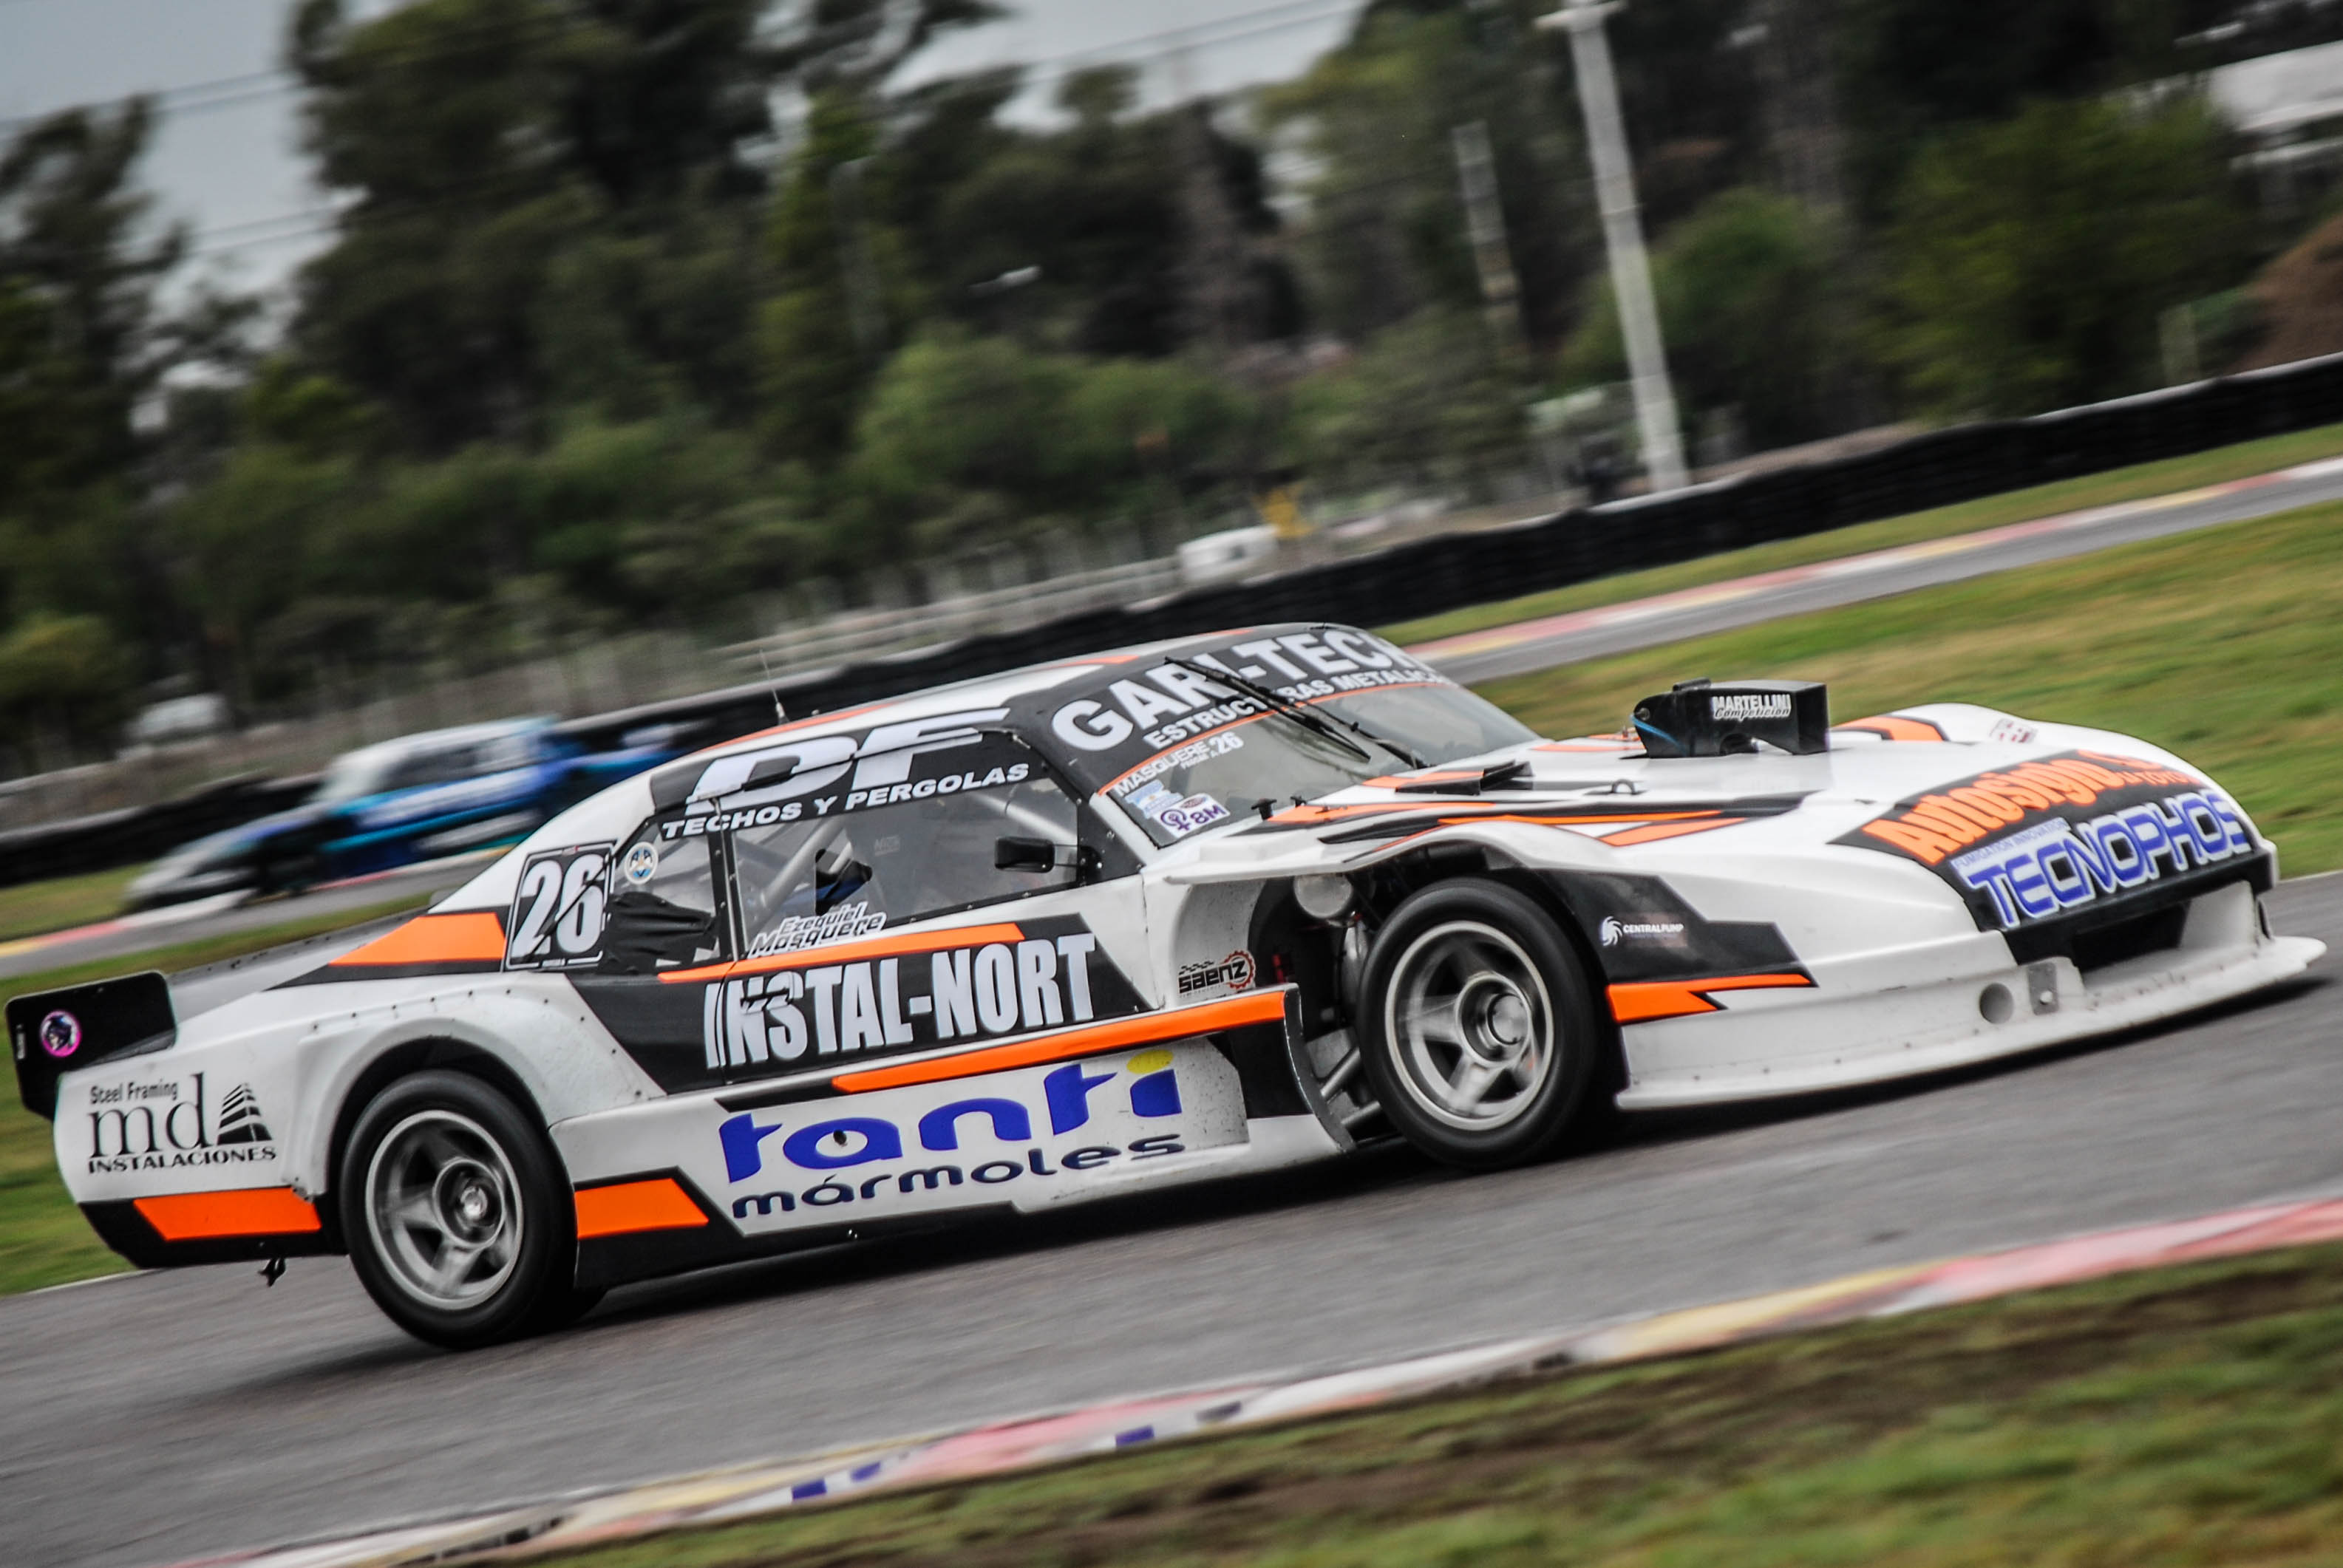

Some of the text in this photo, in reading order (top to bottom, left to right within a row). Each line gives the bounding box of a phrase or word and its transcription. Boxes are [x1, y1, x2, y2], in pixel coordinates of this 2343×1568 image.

[1143, 679, 1335, 749] ESTRUCTRAS
[1711, 694, 1791, 710] MARTELLINI
[684, 708, 1010, 816] DF
[1113, 740, 1211, 797] MASQUERE
[1209, 731, 1244, 754] 26
[662, 763, 1030, 839] TECHOS Y PERGOLAS
[1190, 804, 1228, 825] 8M
[1968, 788, 2252, 927] TECNOPHOS
[511, 853, 605, 958] 26
[747, 912, 887, 960] Masquere
[781, 901, 868, 934] Ezequiel
[704, 933, 1095, 1070] INSTAL-NORT
[87, 1071, 215, 1159] md
[90, 1078, 178, 1105] Steel Framing
[88, 1146, 277, 1173] INSTALACIONES
[732, 1133, 1186, 1220] mármoles
